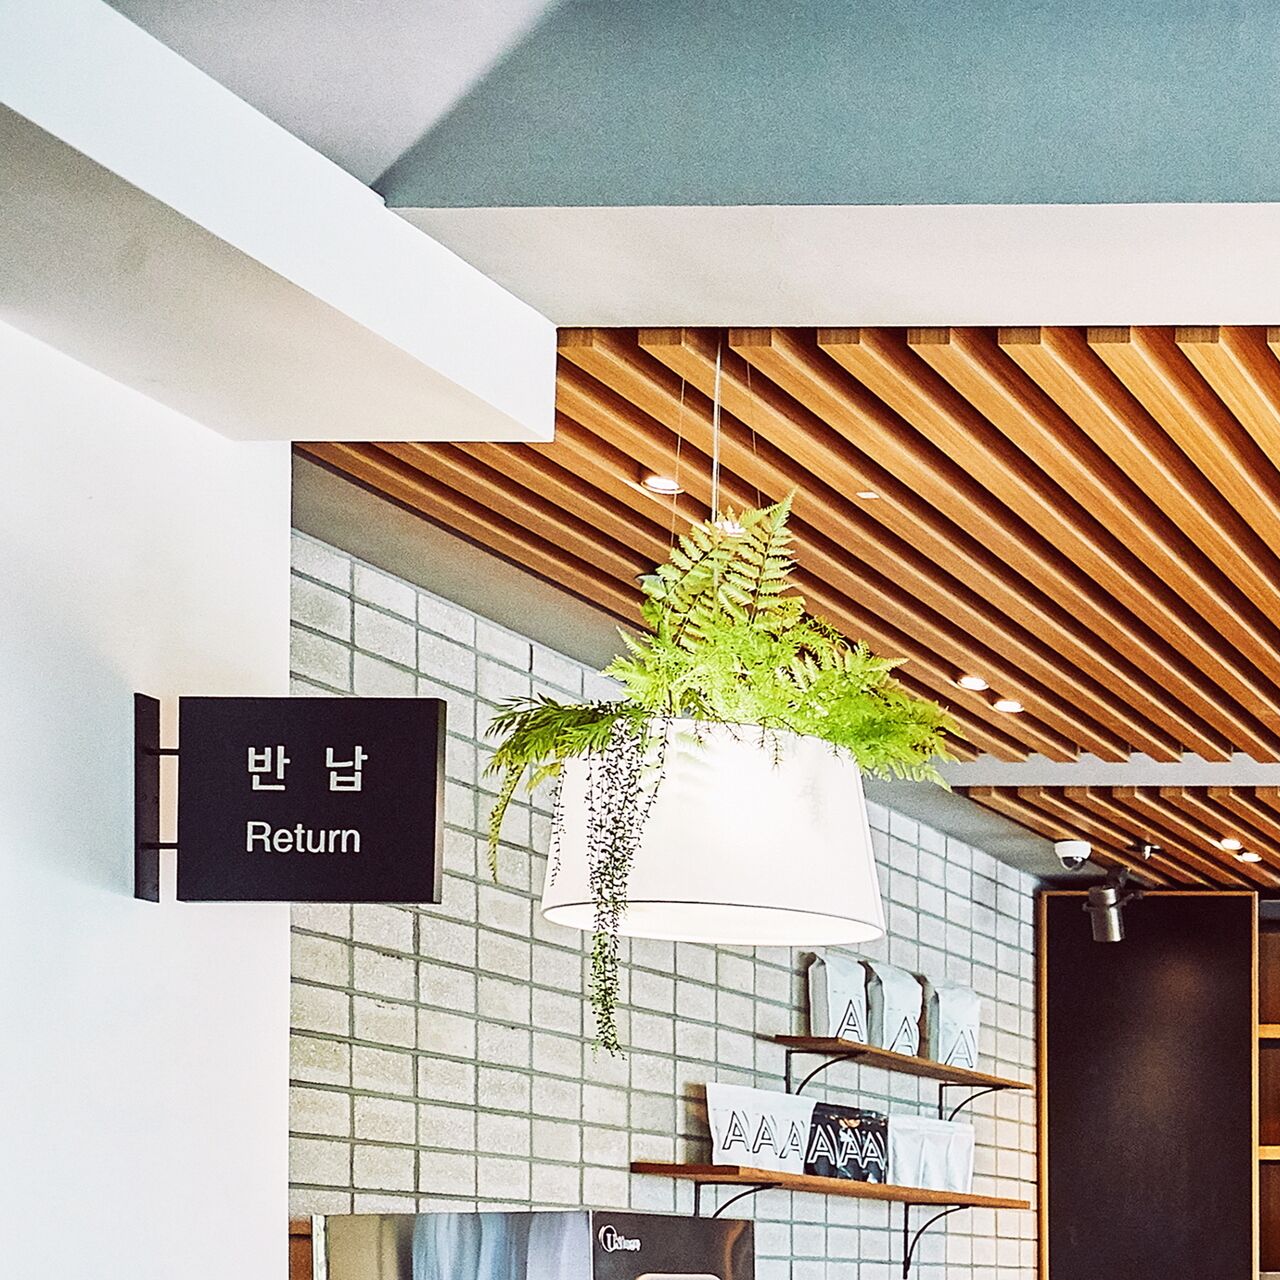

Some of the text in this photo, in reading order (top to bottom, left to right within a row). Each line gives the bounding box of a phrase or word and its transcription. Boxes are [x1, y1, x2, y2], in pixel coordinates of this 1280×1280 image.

[248, 746, 368, 791] 반 납
[247, 821, 360, 852] Return
